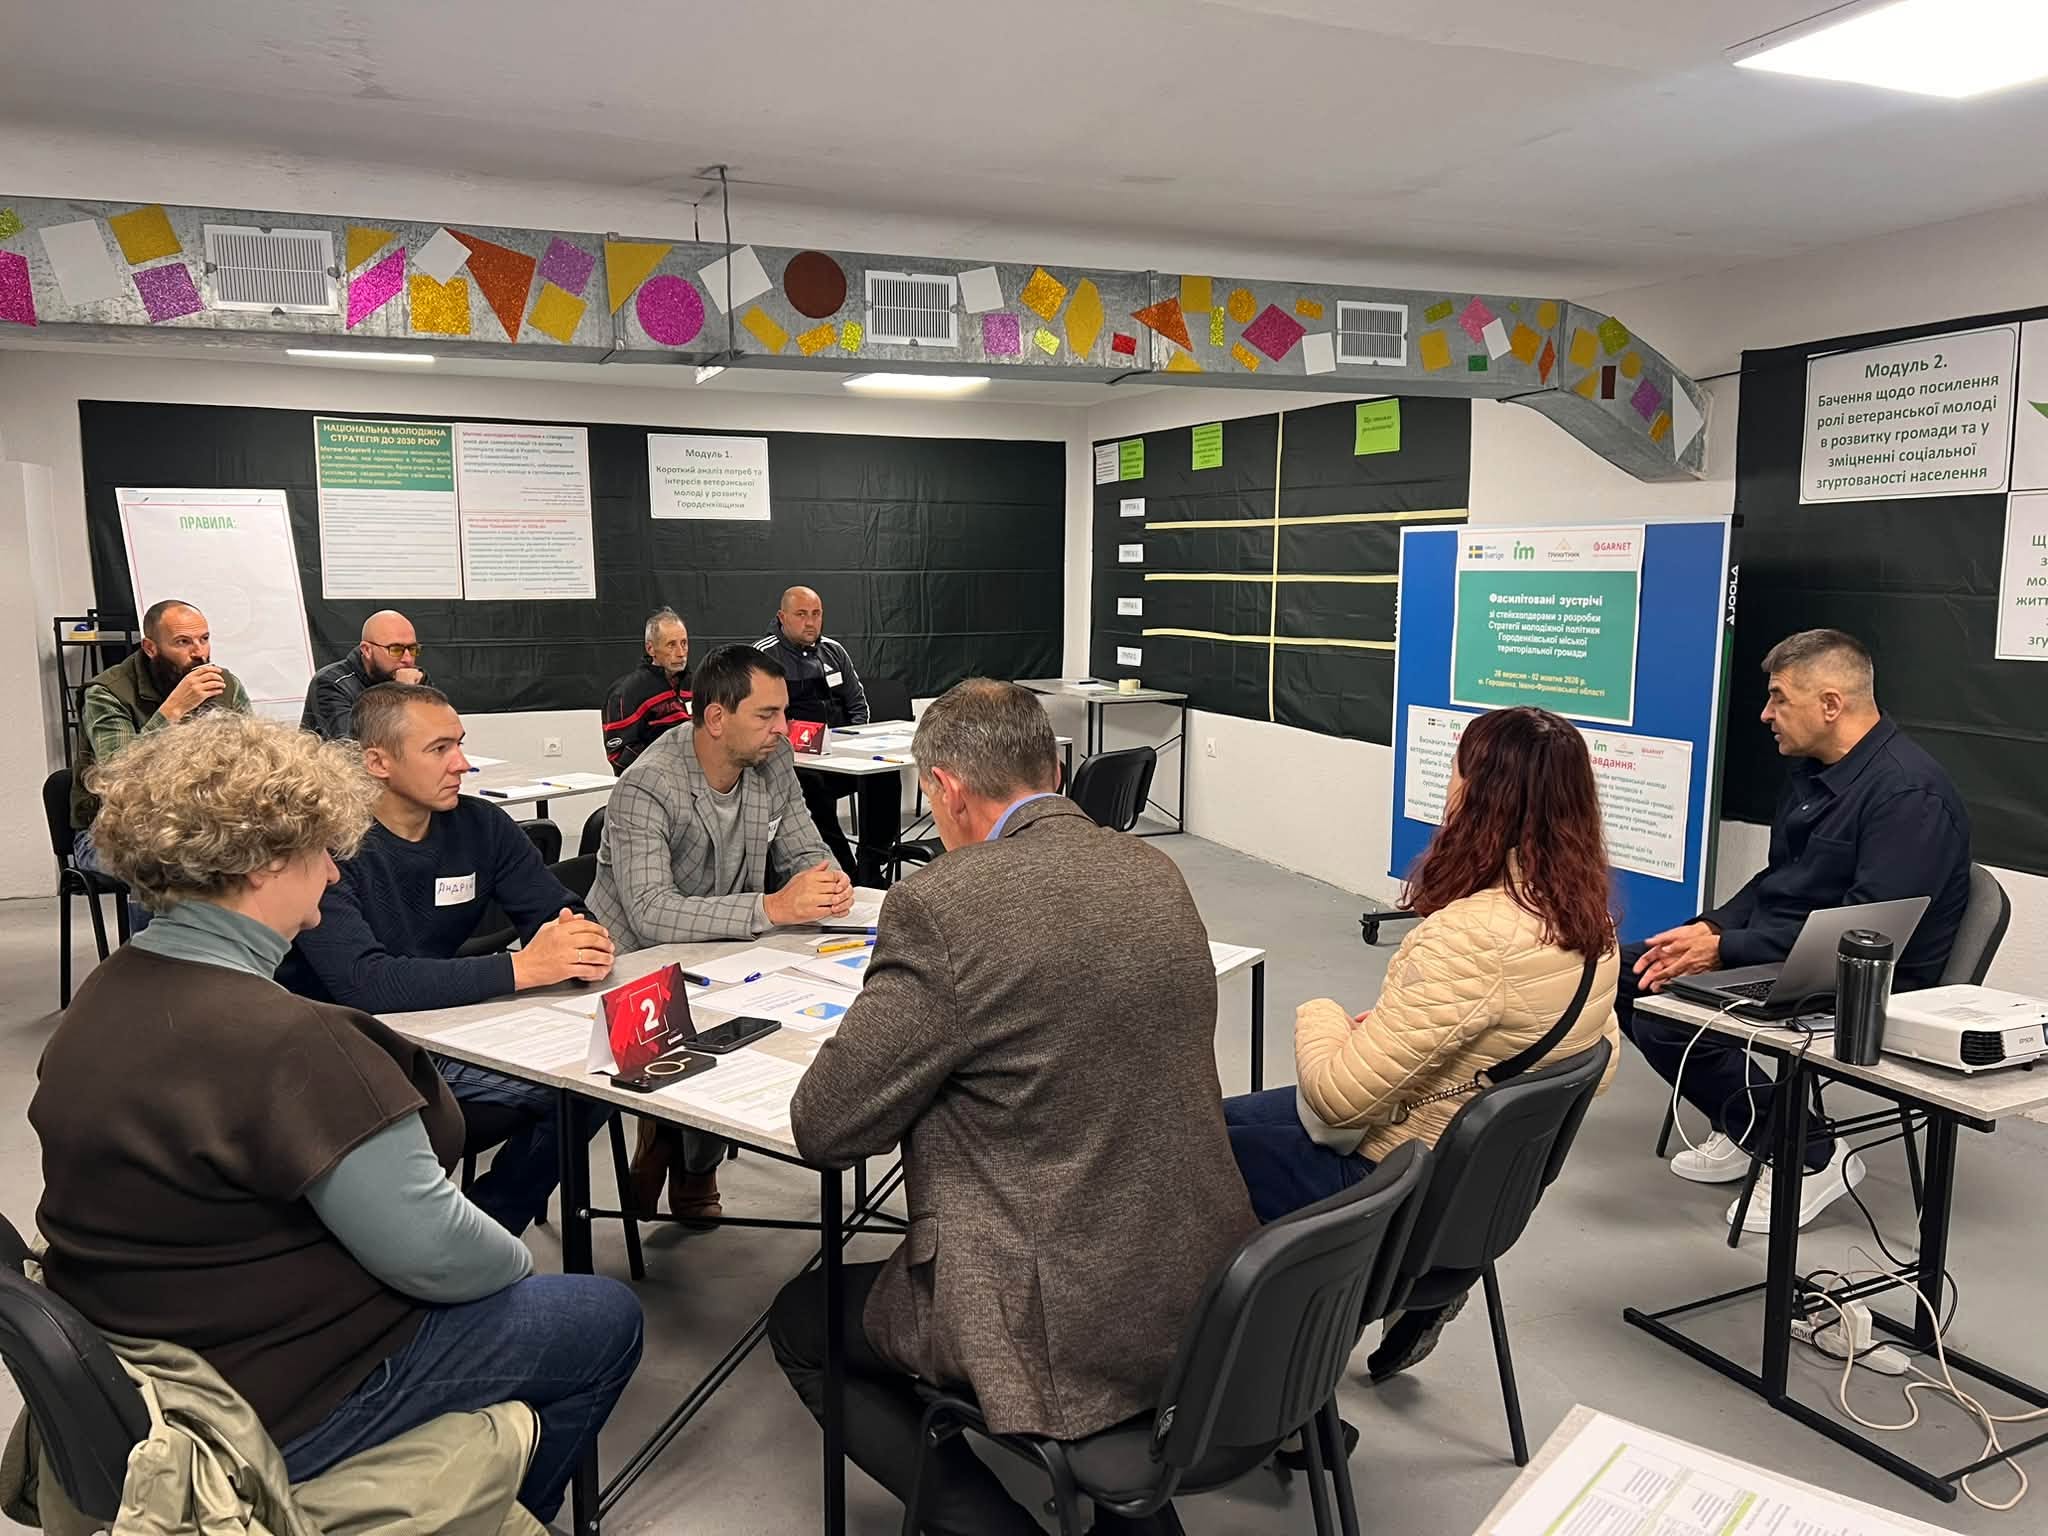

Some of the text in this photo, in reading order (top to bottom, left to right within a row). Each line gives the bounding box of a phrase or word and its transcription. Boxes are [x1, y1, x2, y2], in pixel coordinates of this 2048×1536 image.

[1864, 354, 1948, 379] Модуль 2.
[1818, 375, 1999, 408] Бачення щодо посилення
[1817, 395, 1997, 430] ролі ветеранської молоді
[323, 424, 447, 437] НАЦІОНАЛЬНА МОЛОДІЖНА
[1821, 422, 1990, 448] в розвитку громади та у
[330, 434, 379, 443] СТРАТЕГІЯ
[397, 437, 416, 445] 2030
[418, 438, 441, 446] РОКУ
[685, 449, 722, 459] Модуль
[1828, 443, 1976, 468] зміцненні соціальної
[656, 466, 696, 475] Короткий
[1816, 467, 1988, 490] згуртованості населення
[180, 516, 236, 529] ПРАВИЛА:
[1601, 542, 1632, 551] GARNET
[2027, 577, 2048, 586] мо
[1728, 564, 1739, 614] JOOLA
[1489, 593, 1603, 608] Фасилітовані зустрічі
[2016, 597, 2048, 606] житт
[1563, 613, 1601, 622] розробки
[1488, 621, 1600, 634] Стратегії молодіжної політики
[1498, 632, 1587, 646] Городенківської міської
[2028, 637, 2048, 648] згу
[1498, 645, 1587, 658] територіальної громади
[800, 729, 810, 743] 4
[640, 998, 660, 1032] 2
